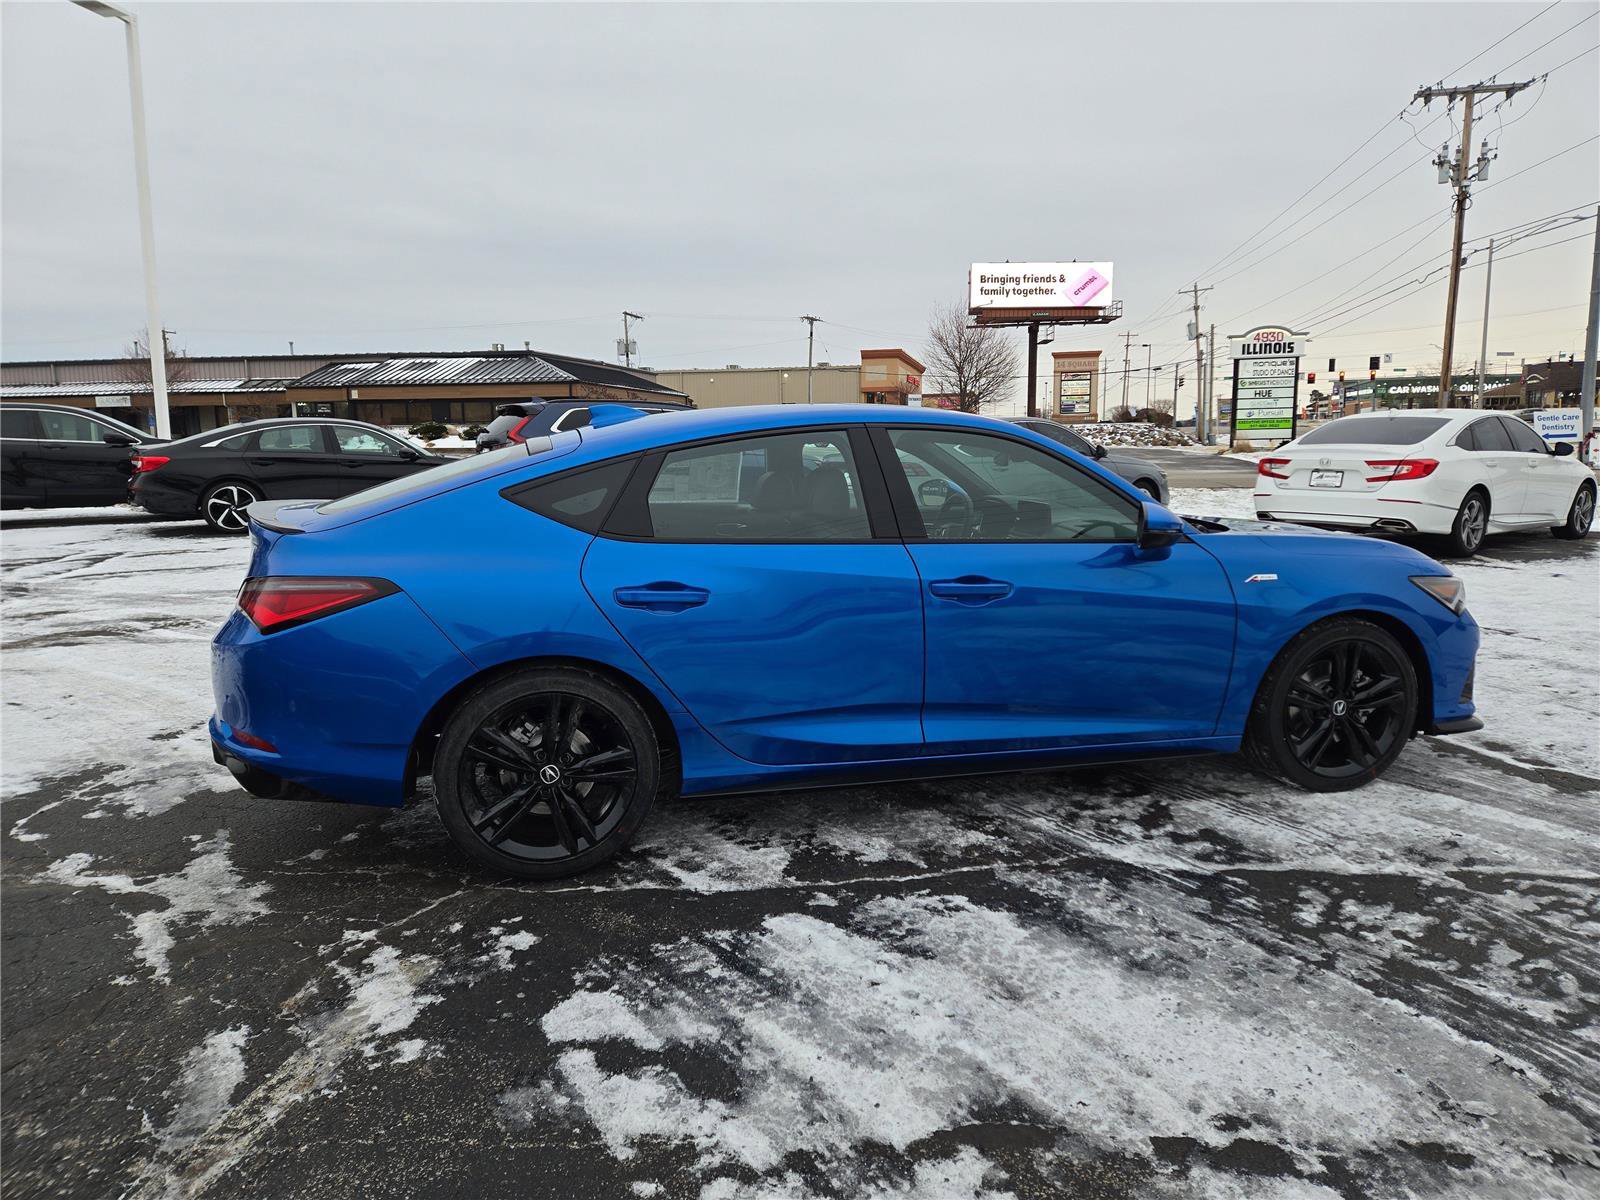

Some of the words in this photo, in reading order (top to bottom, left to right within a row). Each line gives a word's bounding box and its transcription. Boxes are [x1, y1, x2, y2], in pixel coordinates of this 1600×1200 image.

[980, 275, 1021, 286] Bringing
[1023, 274, 1056, 283] friends
[1059, 275, 1066, 283] &
[1074, 275, 1097, 296] crumbl
[980, 287, 1010, 298] family
[1012, 286, 1056, 297] together.
[1254, 332, 1284, 342] 4930
[1242, 342, 1294, 355] ILLINOIS
[1389, 386, 1410, 394] CAR
[1411, 385, 1440, 393] WASH
